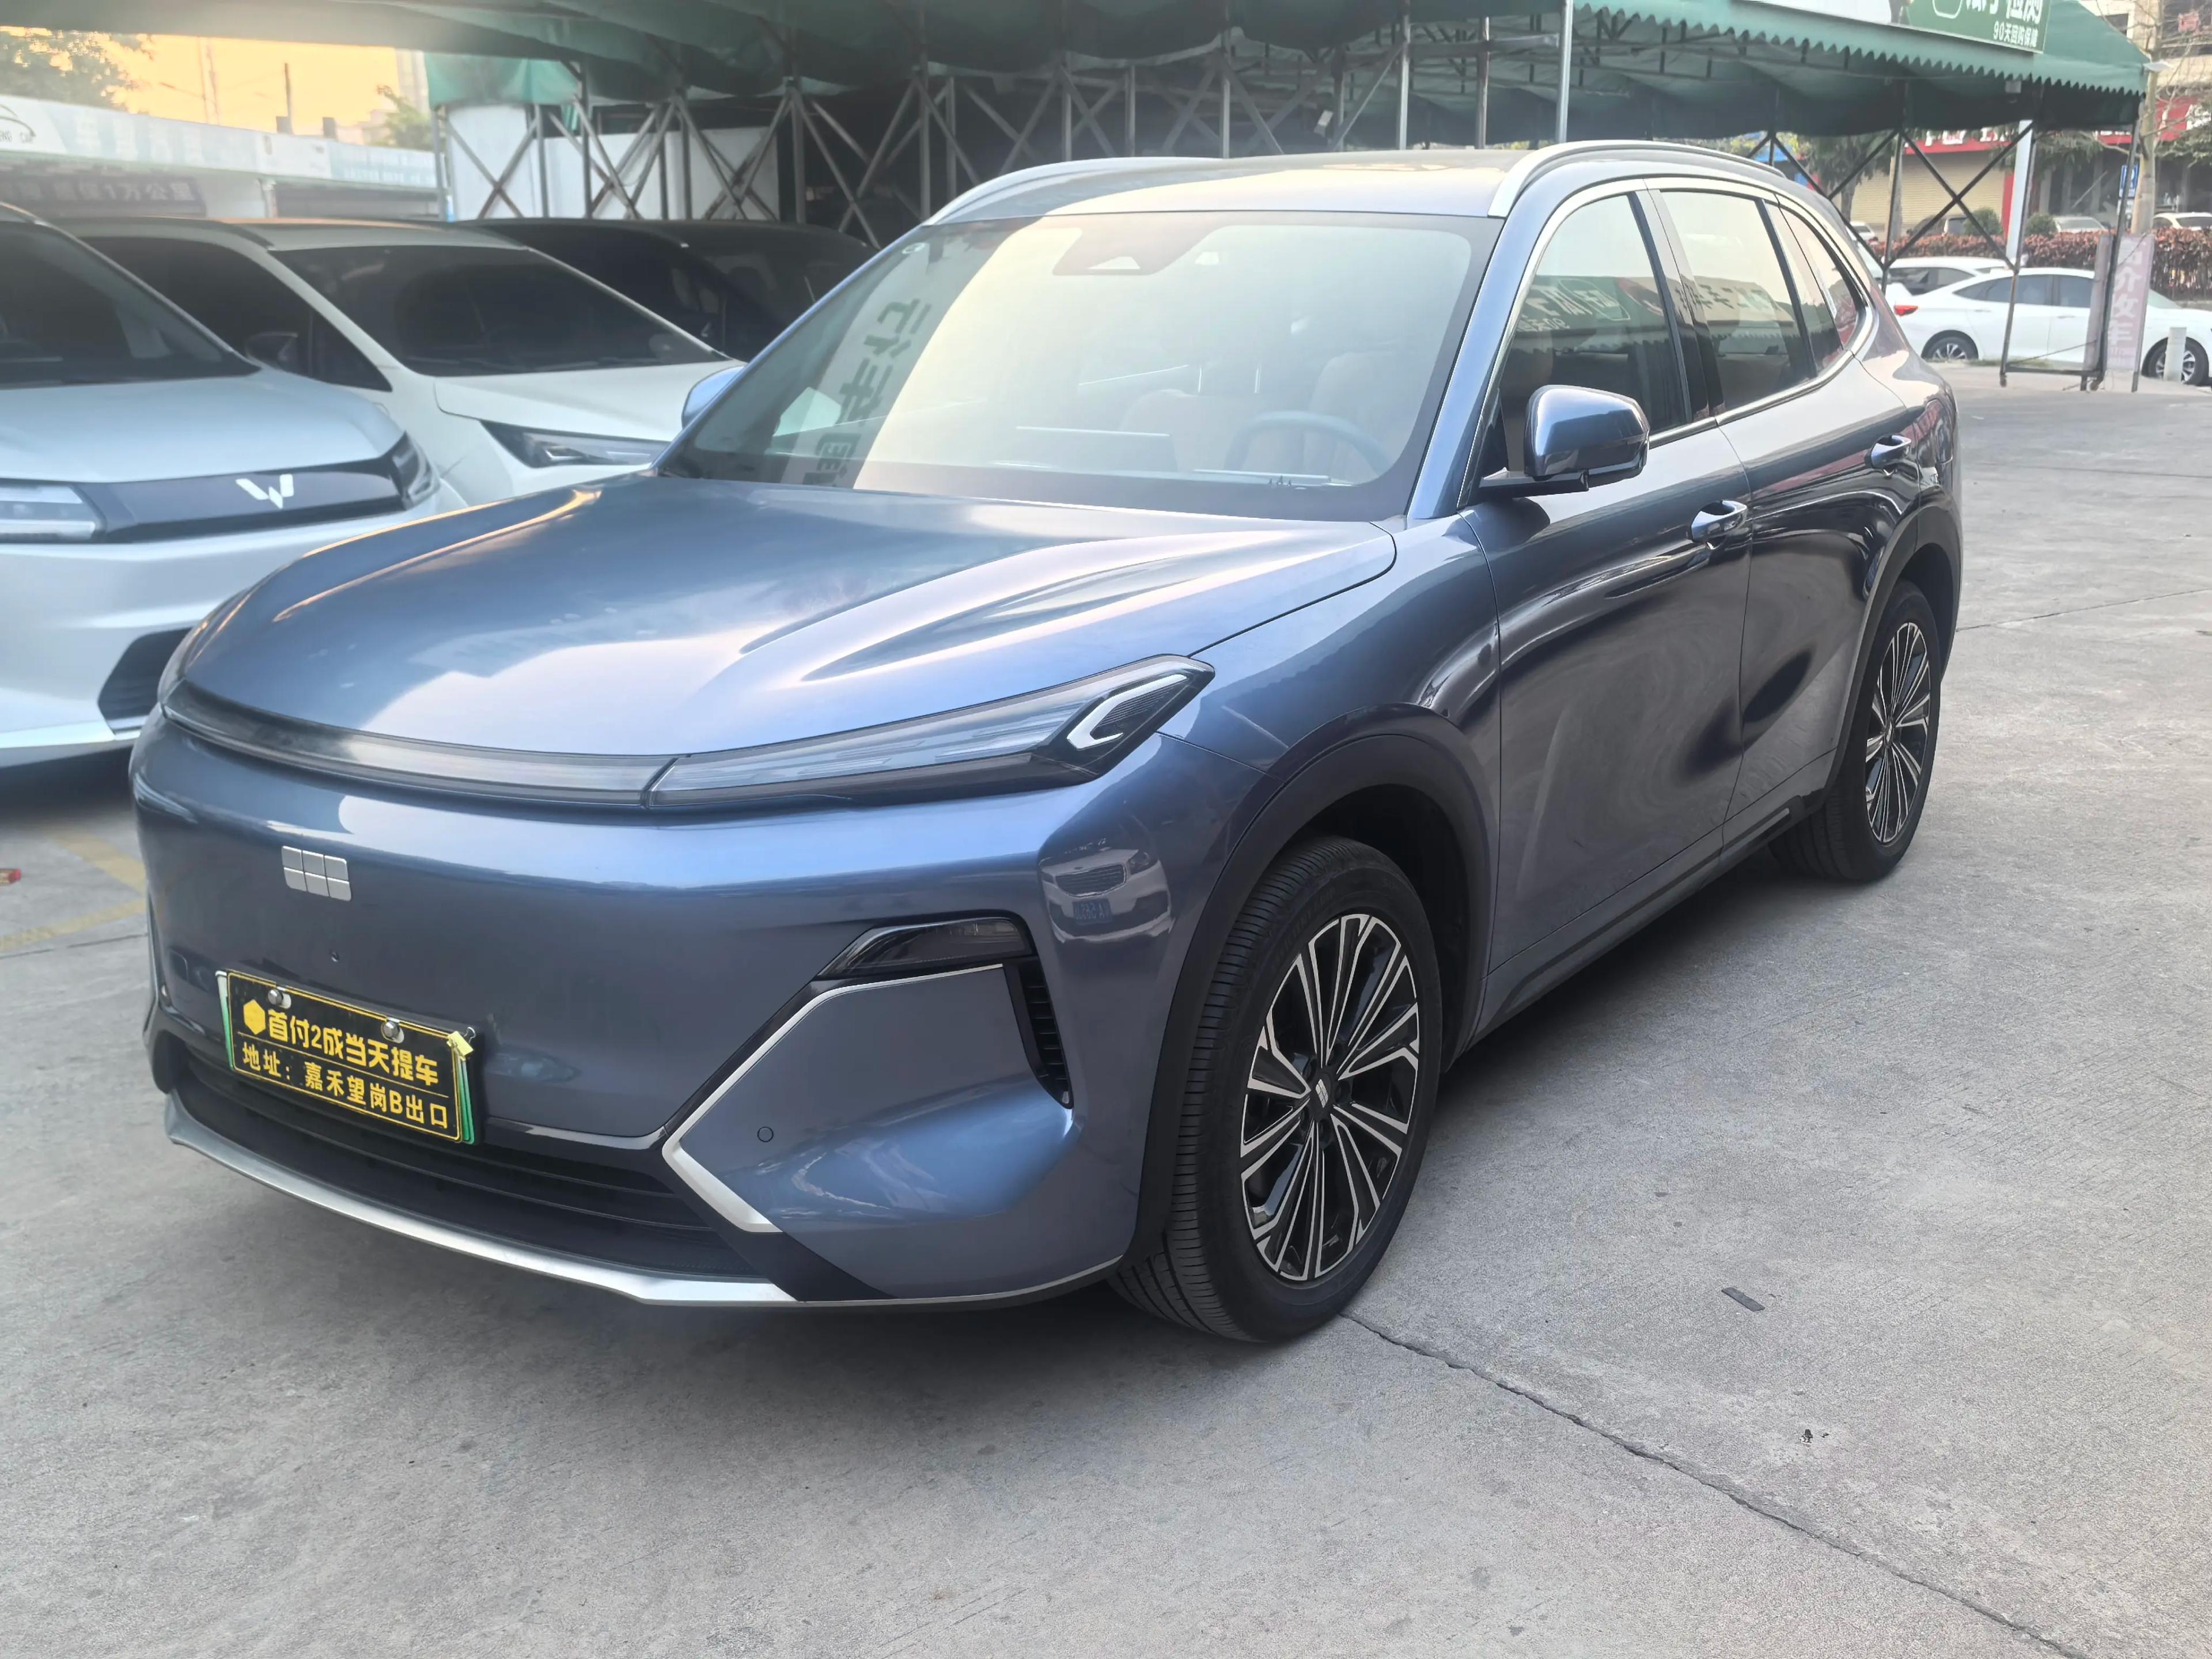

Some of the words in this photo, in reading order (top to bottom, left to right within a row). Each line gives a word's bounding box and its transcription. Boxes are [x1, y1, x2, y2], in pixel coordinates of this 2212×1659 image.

[268, 1009, 438, 1086] 首付2成当天提车
